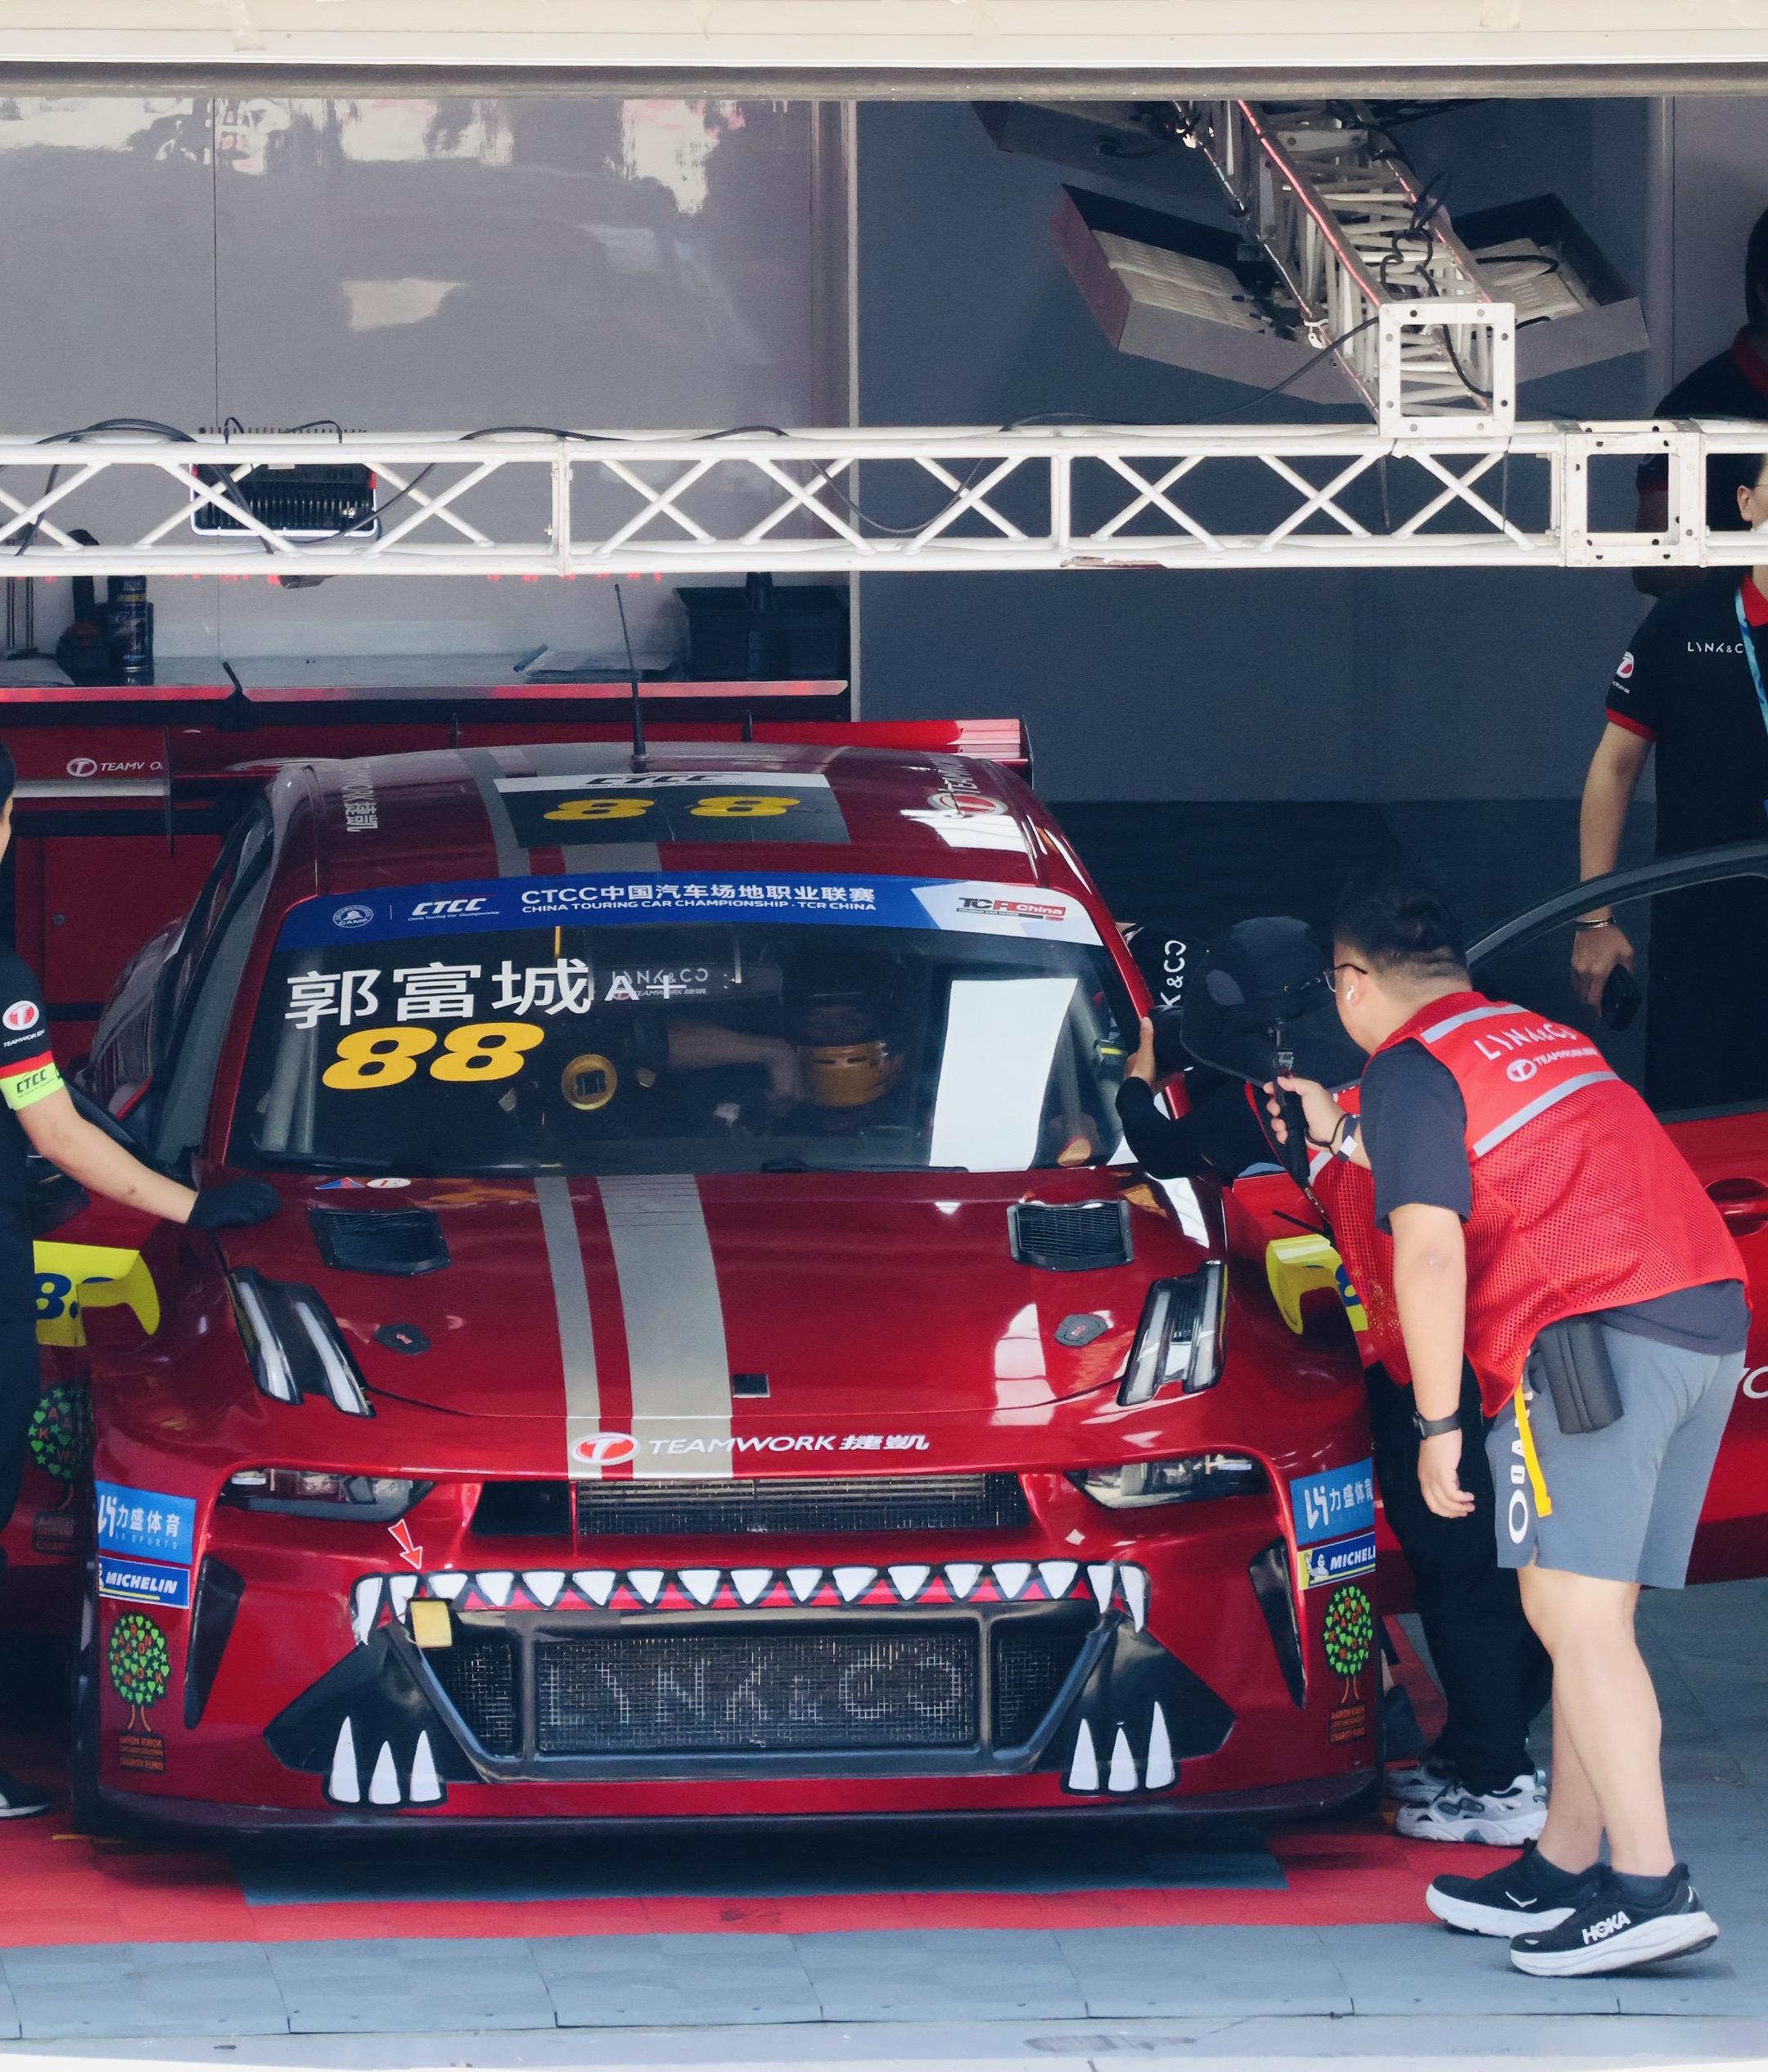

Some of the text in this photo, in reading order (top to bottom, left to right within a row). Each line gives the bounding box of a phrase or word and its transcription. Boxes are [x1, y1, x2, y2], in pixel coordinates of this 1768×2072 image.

[412, 898, 486, 916] CTCC
[521, 899, 876, 913] CHINA TOURING CAR CHAMPIONSHIP TCR CHINA
[284, 957, 687, 1030] 郭富城 A+
[322, 1022, 545, 1090] 88
[16, 1069, 47, 1093] CTCC
[648, 1435, 837, 1454] TEAMWORK
[117, 1504, 181, 1538] 力盛体育
[106, 1570, 178, 1595] MICHELIN
[1581, 1910, 1631, 1945] HOKA
